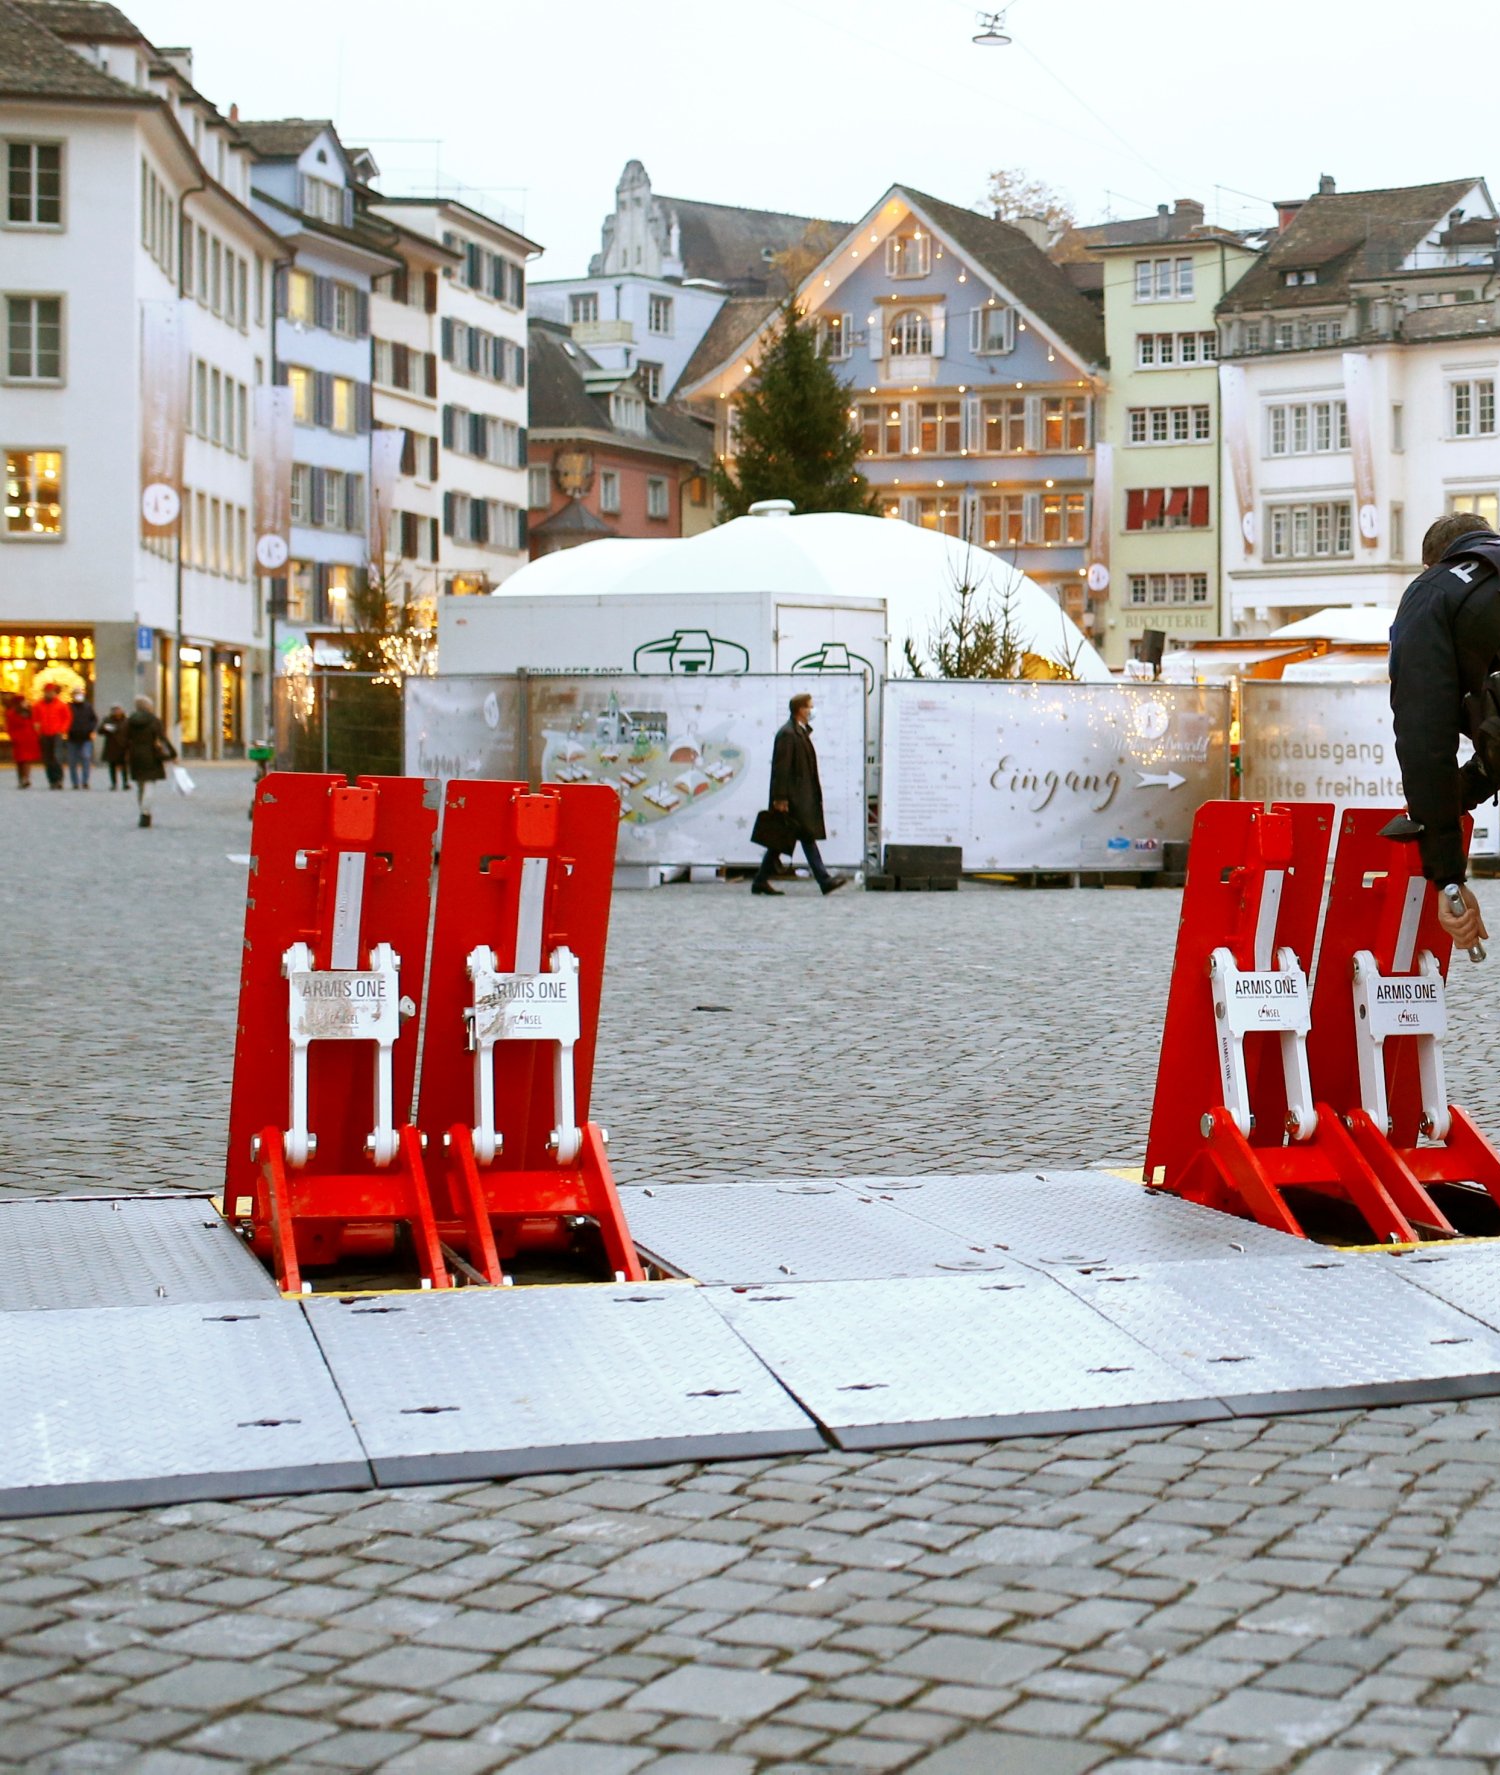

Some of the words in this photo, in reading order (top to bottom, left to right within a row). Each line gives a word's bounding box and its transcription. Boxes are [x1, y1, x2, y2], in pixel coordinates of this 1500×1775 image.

[1125, 614, 1208, 628] BIJOUTERIE
[1254, 739, 1385, 764] Notausgang
[989, 754, 1121, 812] Eingang
[1254, 777, 1306, 798] Bitte
[1316, 776, 1404, 798] freihalte
[302, 980, 352, 998] ARMIS
[356, 980, 386, 998] ONE
[494, 982, 534, 999] RMIS
[538, 982, 567, 999] ONE
[1235, 980, 1272, 995] ARMIS
[1274, 979, 1298, 994] ONE
[1376, 984, 1412, 1000] ARMIS
[1414, 984, 1437, 999] ONE
[1222, 1037, 1230, 1064] ARMIS
